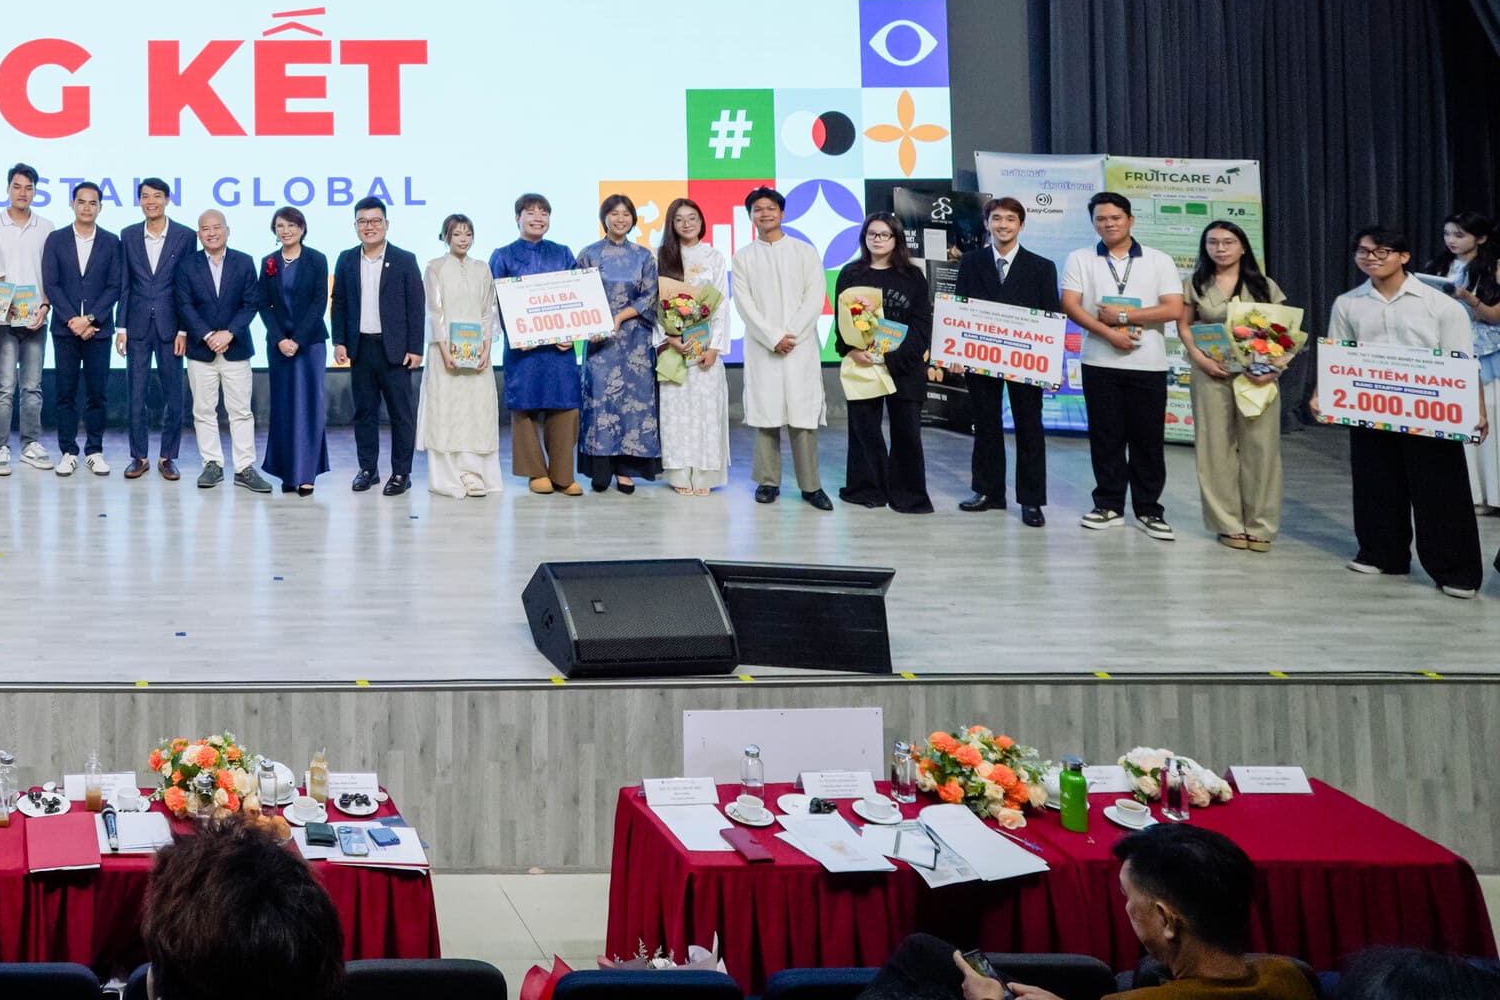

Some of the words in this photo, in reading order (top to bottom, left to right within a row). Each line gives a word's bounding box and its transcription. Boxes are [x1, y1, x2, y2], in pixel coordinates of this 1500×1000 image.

[148, 6, 429, 137] KẾT
[211, 176, 427, 207] GLOBAL
[1124, 170, 1211, 184] FRUITCARE
[1216, 175, 1231, 185] AI
[558, 291, 579, 302] BA
[515, 308, 603, 334] 6.000.000
[943, 338, 1050, 374] 2.000.000
[1332, 388, 1463, 424] 2.000.000
